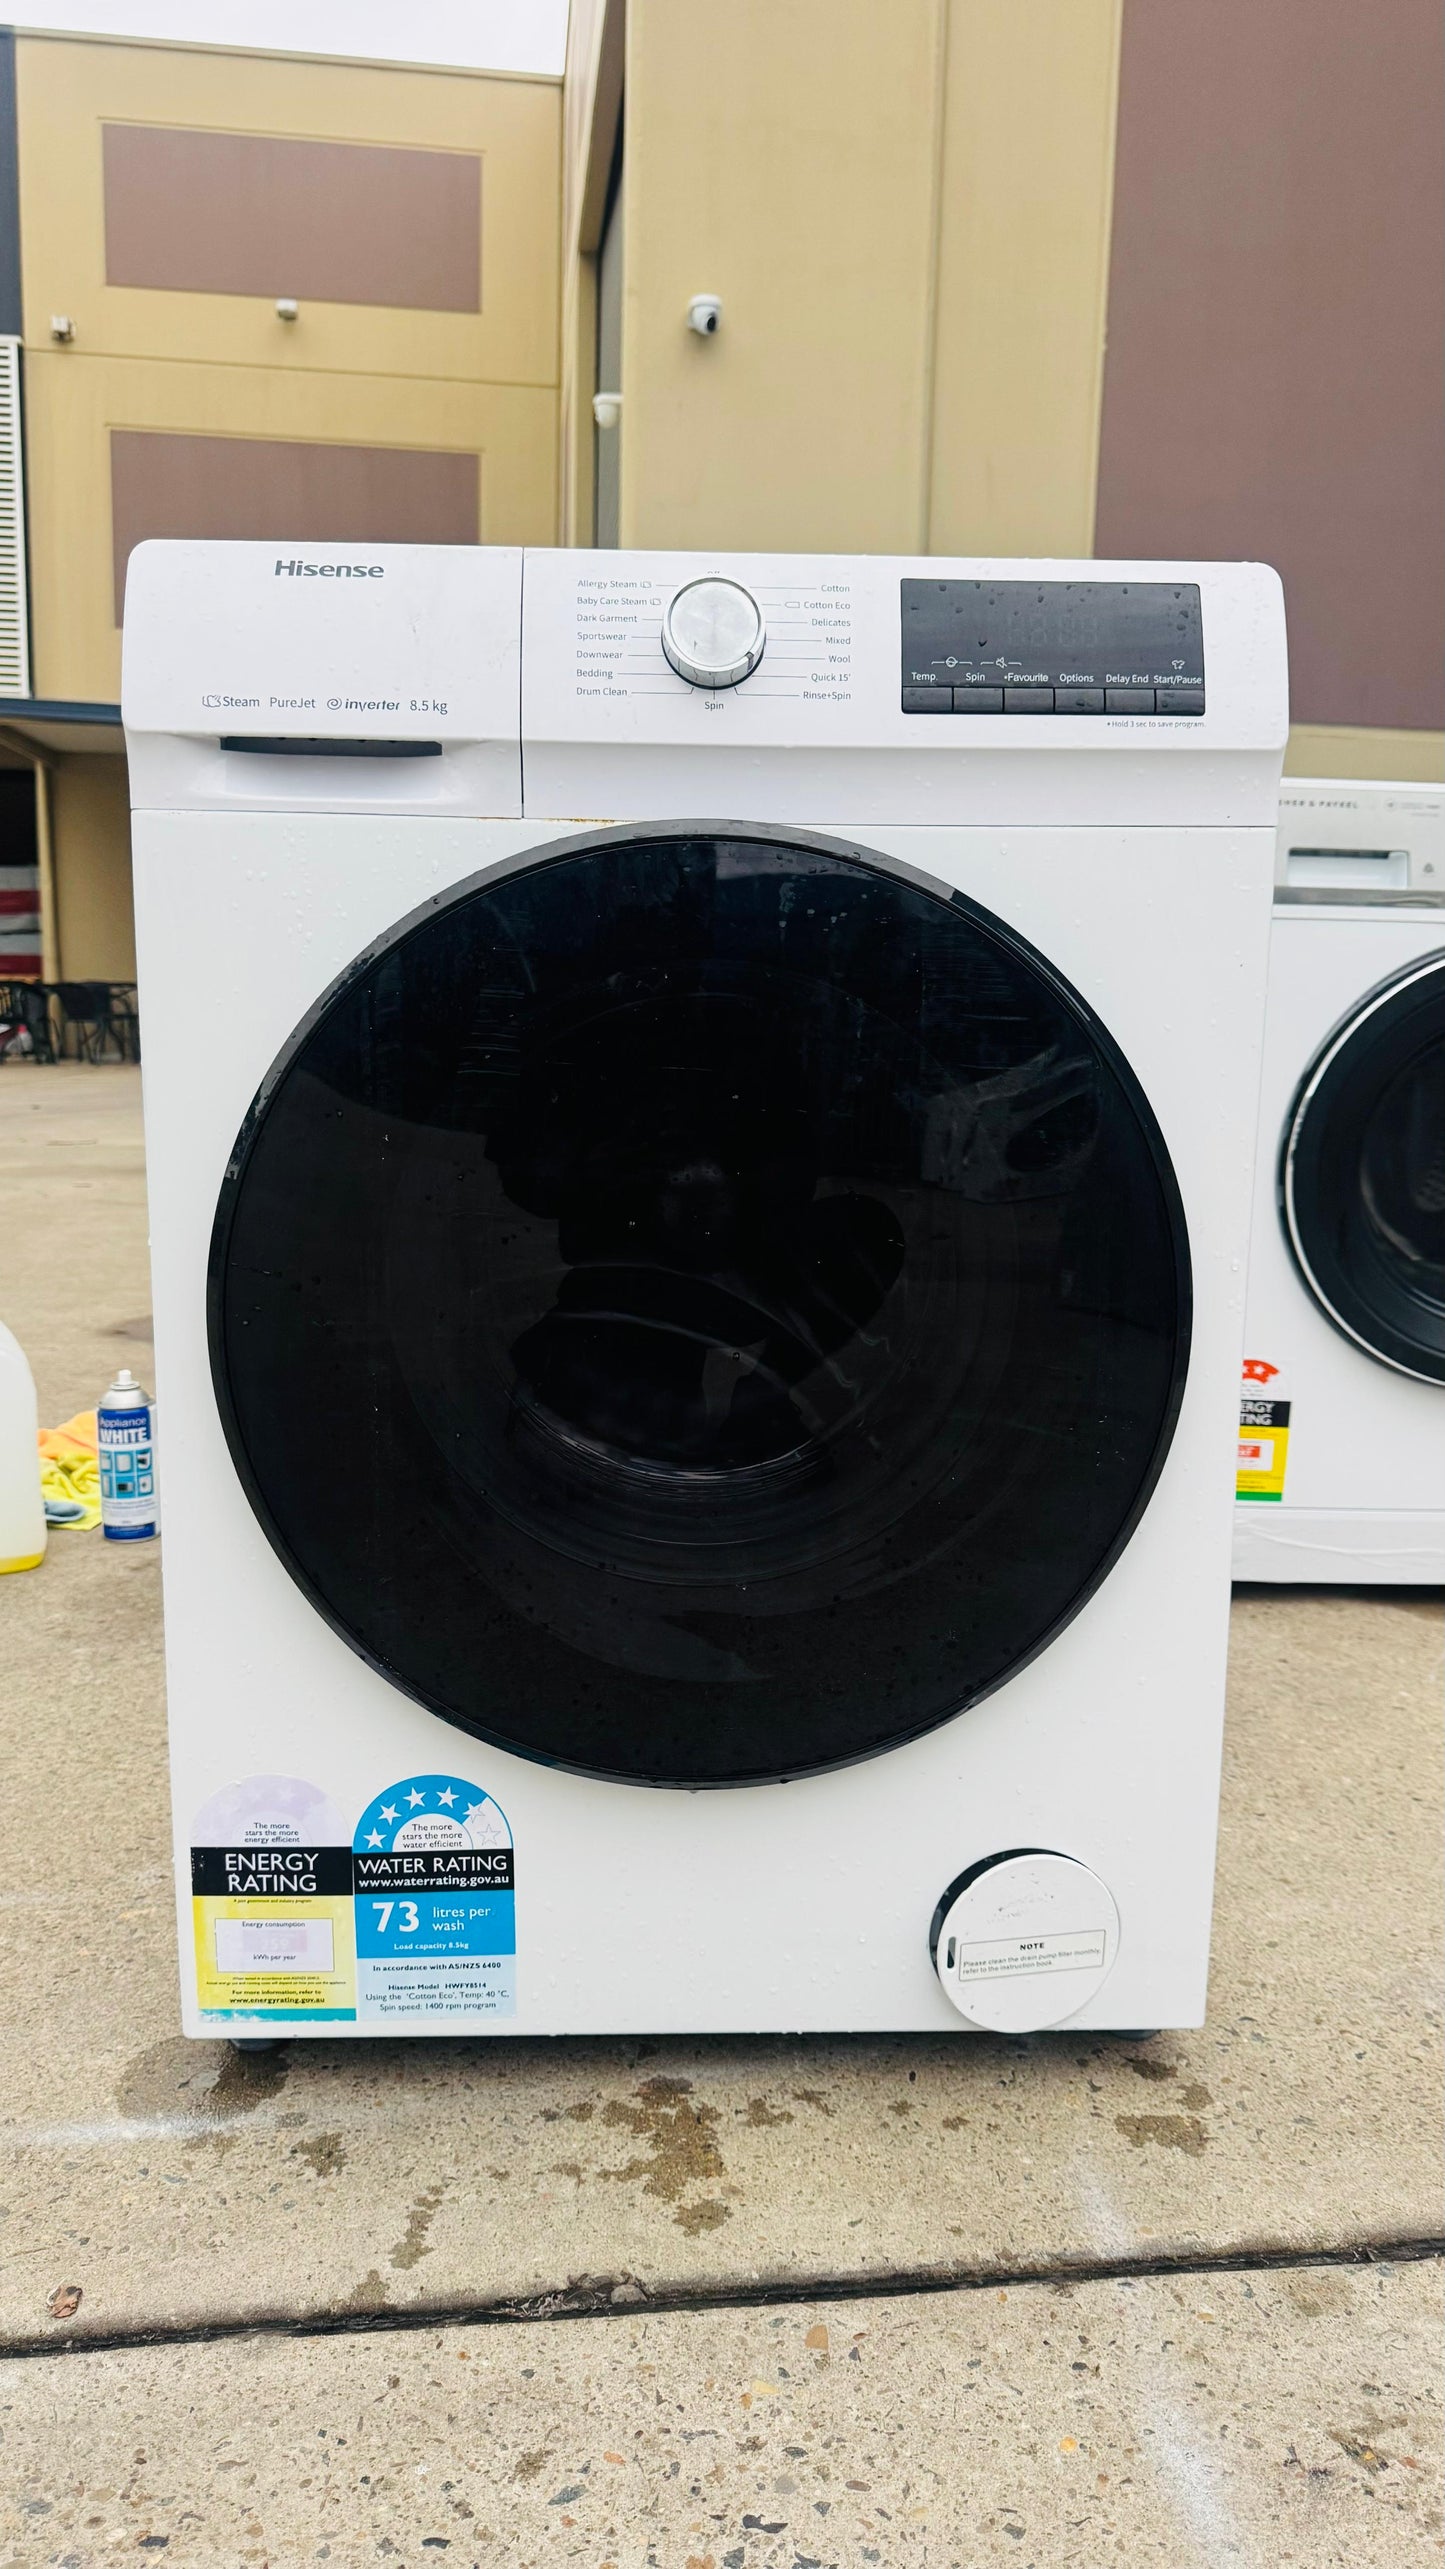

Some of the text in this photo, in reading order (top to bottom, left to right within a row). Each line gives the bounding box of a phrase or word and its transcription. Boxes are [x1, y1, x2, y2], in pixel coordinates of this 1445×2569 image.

[274, 560, 385, 578] Hisense
[577, 579, 637, 589] Allergy Steam
[821, 584, 850, 592] Cotton
[577, 597, 598, 606] Baby
[621, 598, 647, 606] Steam
[803, 601, 851, 610] Cotton Eco
[576, 614, 638, 623] Dark Garment
[811, 619, 851, 627] Delicates
[577, 632, 626, 642] Sportswear
[825, 636, 851, 645] Mixed
[576, 651, 623, 659] Downwear
[828, 655, 851, 663] Wool
[576, 669, 613, 679] Bedding
[811, 673, 837, 682] Quick
[911, 672, 938, 682] Temp.
[965, 672, 985, 682] Spin
[1059, 673, 1094, 683] Options
[1106, 673, 1149, 684] Delay End
[1153, 674, 1202, 685] Start/Pause
[576, 687, 627, 696] Drum Clean
[803, 691, 851, 700] Rinse+Spin
[223, 696, 448, 715] Steam PureJet inverter 8.5 kg
[704, 701, 724, 710] Spin
[100, 1417, 147, 1428] Appliance
[100, 1428, 148, 1443] WHITE
[429, 1840, 462, 1848] efficient
[225, 1853, 319, 1871] ENERGY
[359, 1855, 507, 1874] WATER RATING
[228, 1873, 317, 1892] RATING
[359, 1875, 509, 1888] www.waterrating.gov.au
[372, 1901, 419, 1933] 73
[433, 1907, 491, 1919] litres per
[433, 1920, 464, 1930] wash
[415, 1942, 446, 1950] capacity
[1019, 1942, 1045, 1950] NOTE
[1008, 1955, 1019, 1963] the
[1038, 1953, 1057, 1961] pump
[963, 1967, 978, 1975] refer
[1000, 1962, 1035, 1971] instruction
[380, 2004, 396, 2012] Spin
